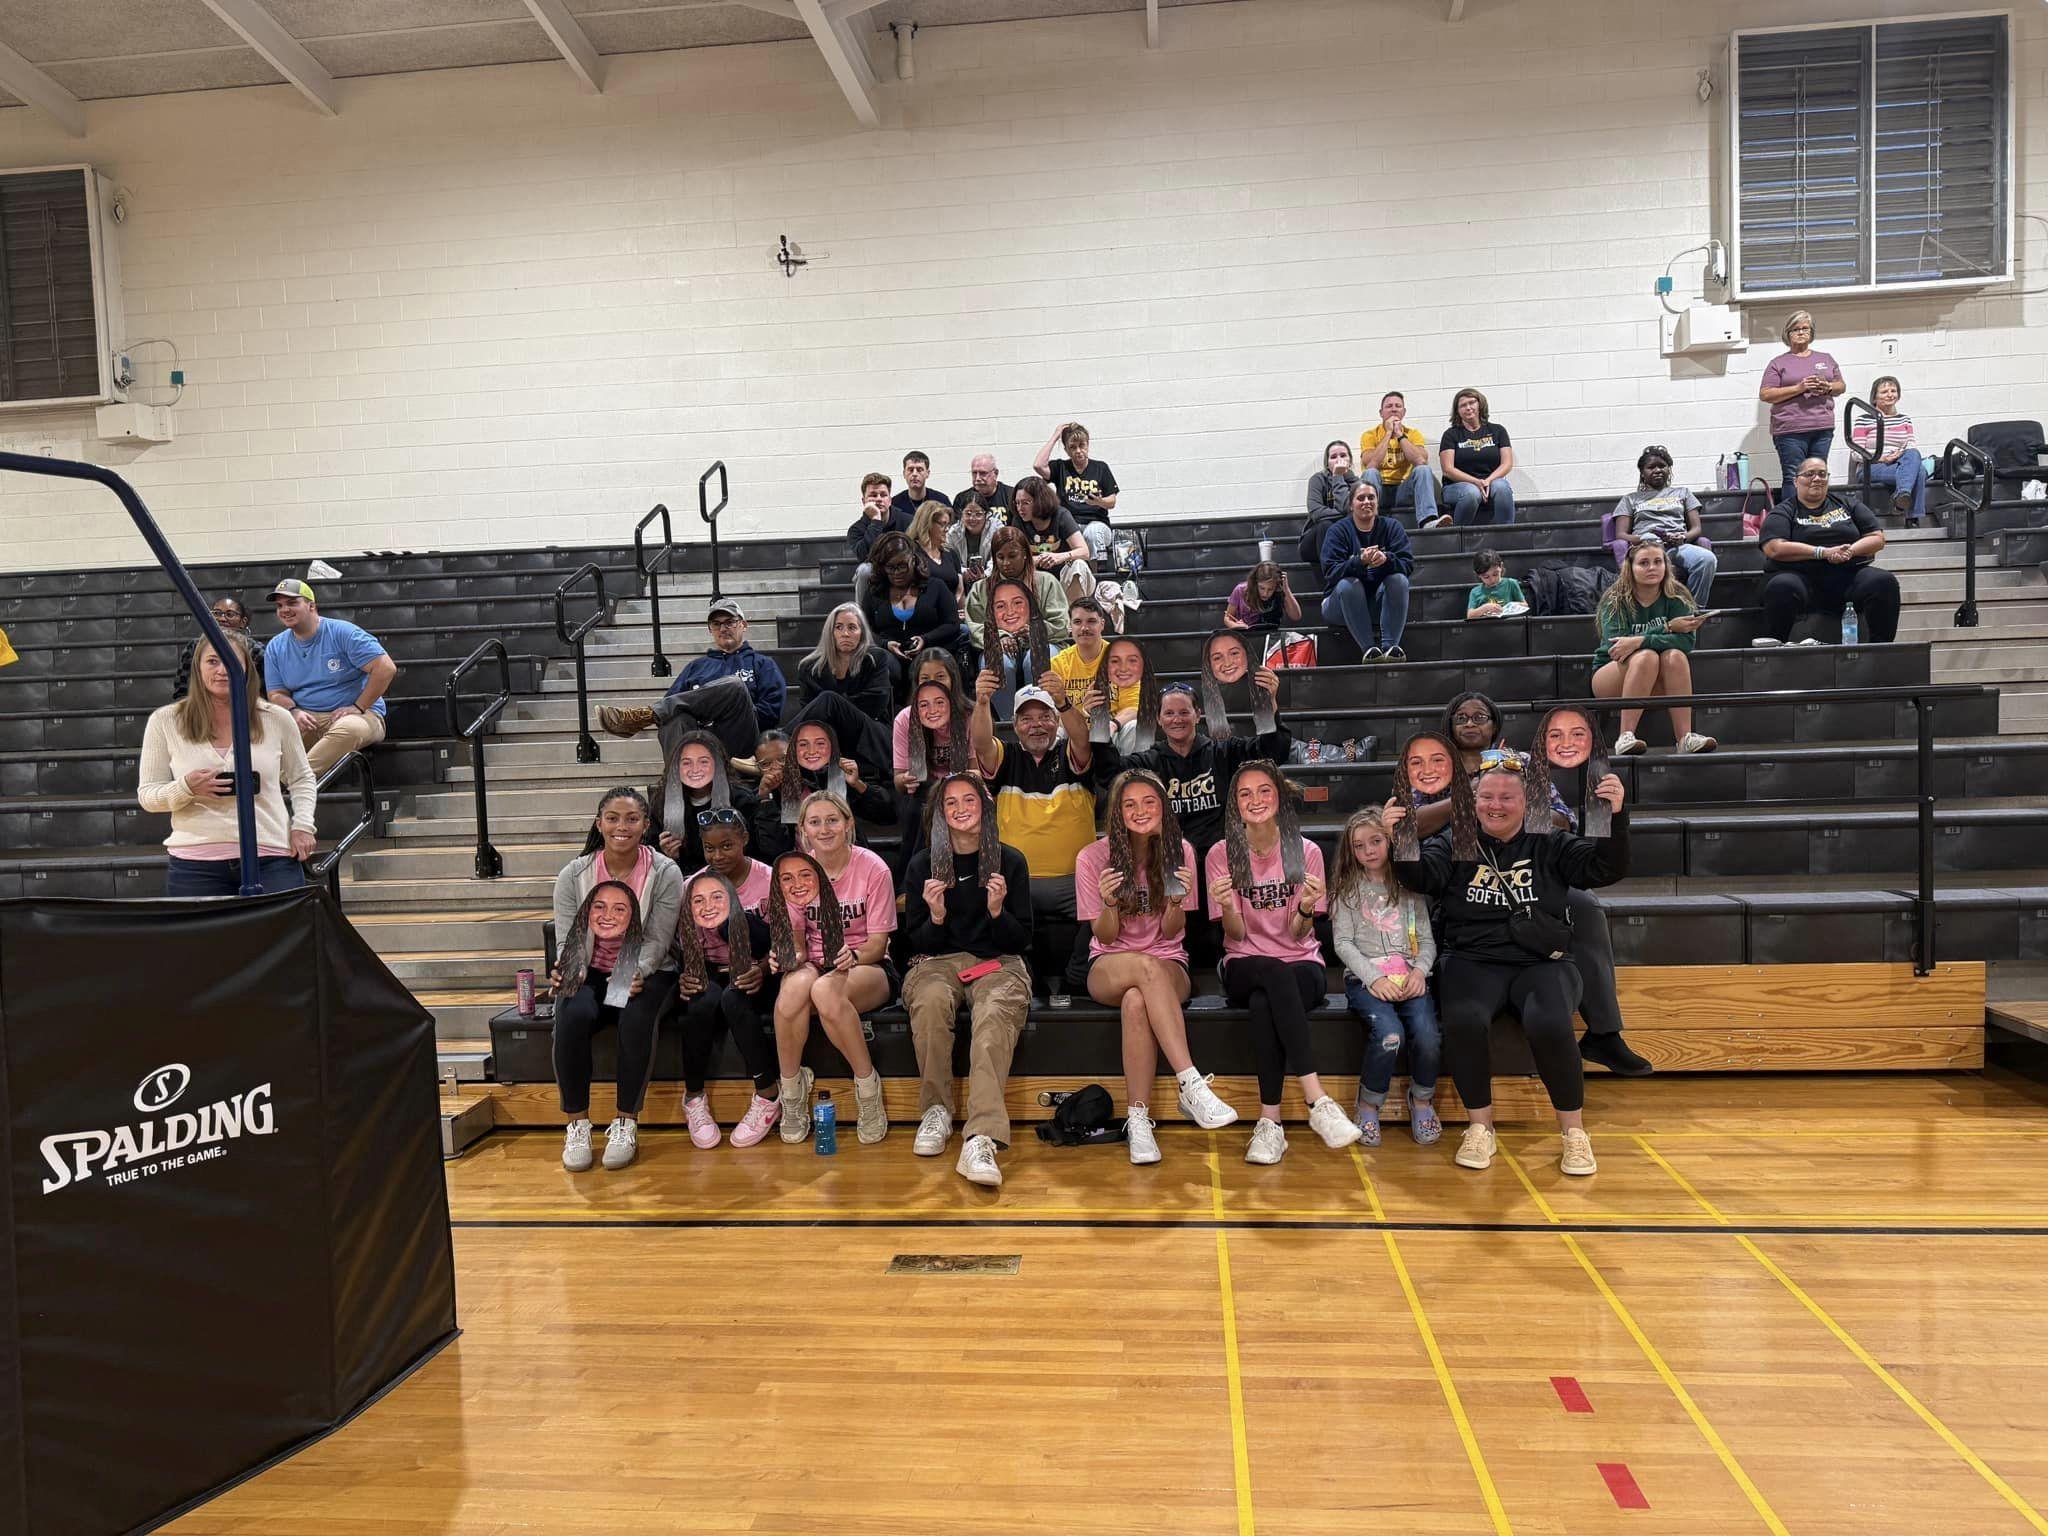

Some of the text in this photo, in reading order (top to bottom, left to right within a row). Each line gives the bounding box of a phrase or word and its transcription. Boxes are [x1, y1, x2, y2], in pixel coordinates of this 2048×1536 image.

[39, 1082, 275, 1196] SPALDING
[105, 1145, 223, 1187] TRUE TO THE GAME
